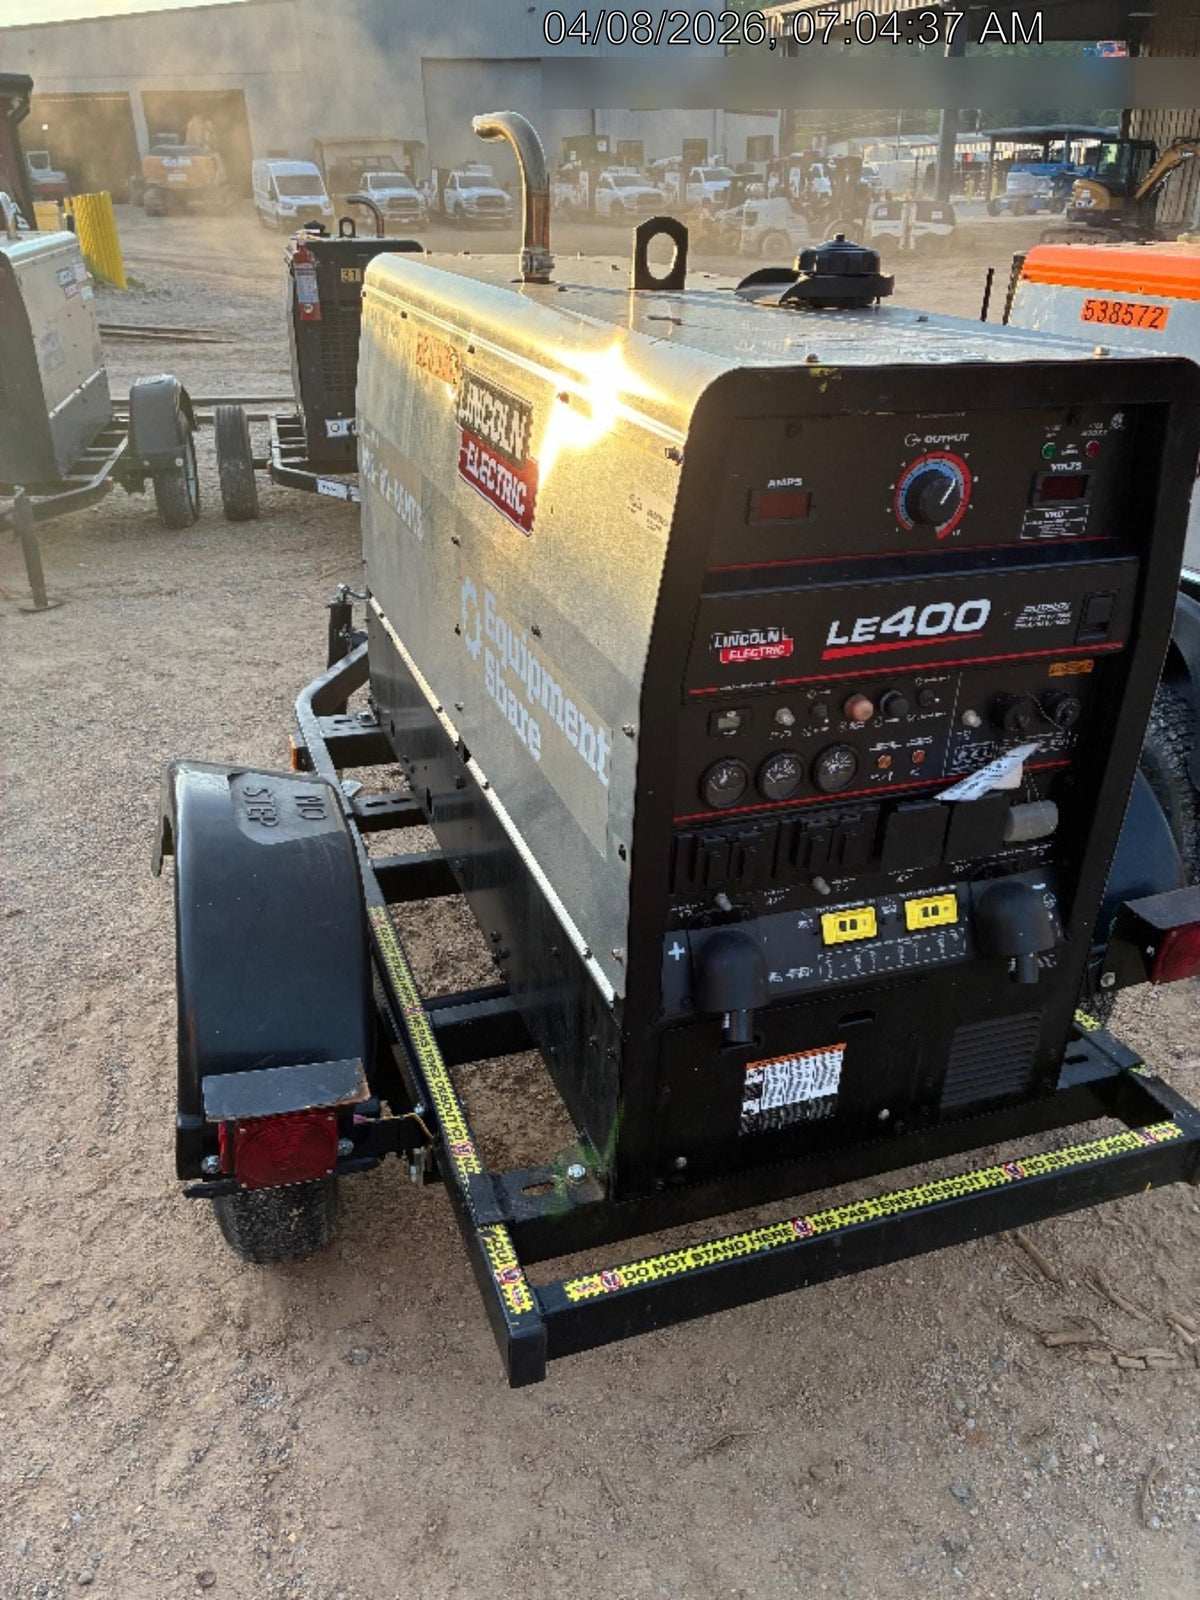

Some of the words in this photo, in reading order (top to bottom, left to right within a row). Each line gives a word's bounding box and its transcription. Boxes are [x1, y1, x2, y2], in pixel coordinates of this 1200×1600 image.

[1084, 299, 1165, 329] 538572
[459, 379, 528, 460] LINCOLN
[924, 433, 970, 444] OUTPUT
[466, 440, 527, 517] ELECTRIC
[767, 477, 803, 488] AMPS
[1051, 462, 1083, 472] VOLTS
[714, 631, 782, 649] LINCOLN
[825, 598, 992, 646] LE400
[728, 645, 786, 661] ELECTRIC
[484, 586, 611, 788] Equipment
[484, 646, 542, 763] Share
[294, 794, 328, 820] NO
[1022, 1159, 1045, 1172] NO
[1105, 1135, 1139, 1149] AQUI
[813, 1215, 835, 1228] NE
[838, 1207, 870, 1221] PAS
[870, 1192, 919, 1212] TENEZ
[920, 1177, 983, 1199] DEBOUT
[984, 1171, 1004, 1185] ICI
[622, 1266, 650, 1281] DO
[653, 1256, 689, 1274] NOT
[690, 1239, 746, 1262] STAND
[748, 1227, 793, 1246] HERE
